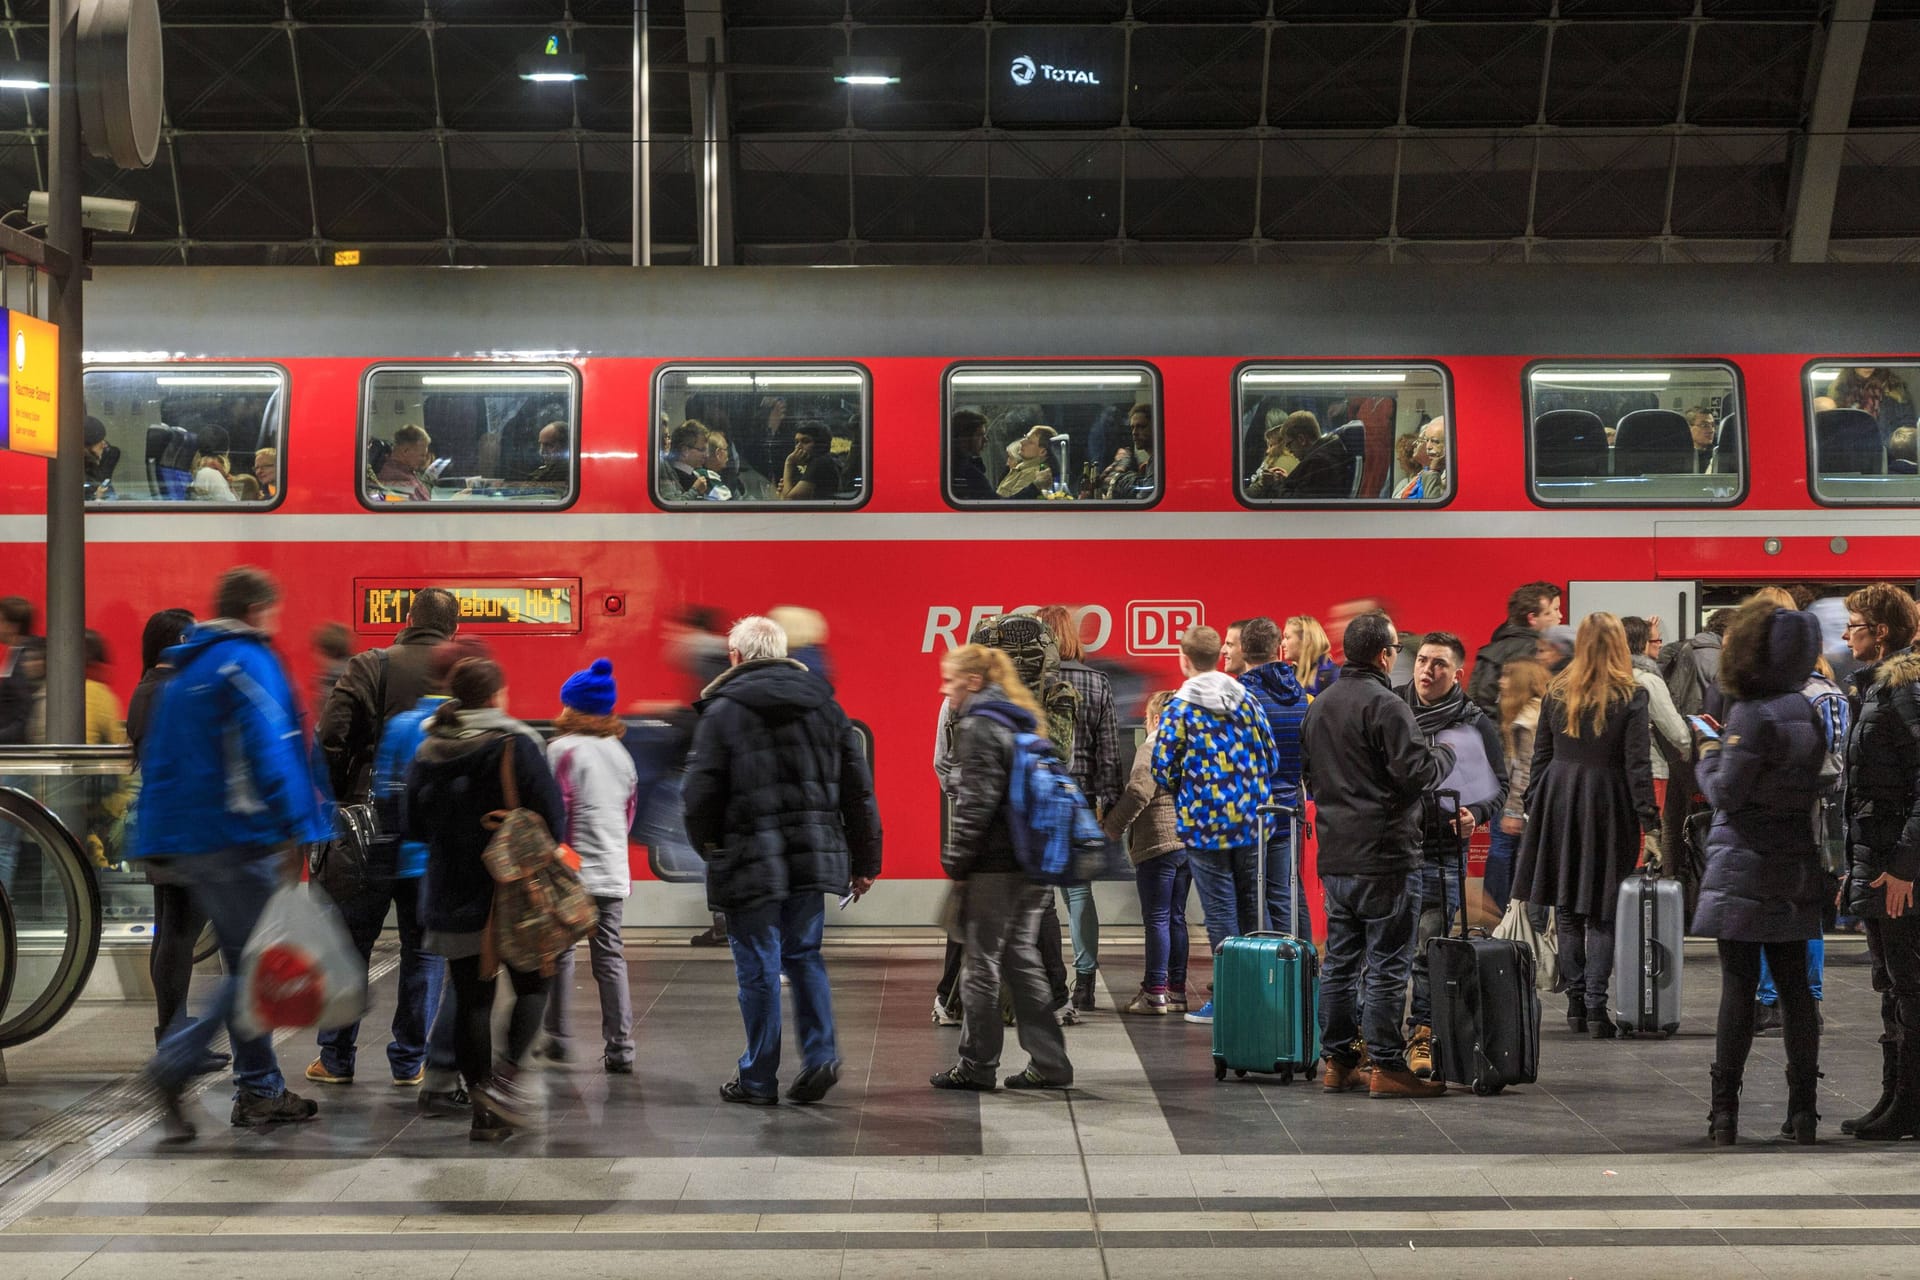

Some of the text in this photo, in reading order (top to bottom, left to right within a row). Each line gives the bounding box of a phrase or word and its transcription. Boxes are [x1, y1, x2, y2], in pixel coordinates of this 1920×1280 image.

[369, 589, 561, 623] RE1 eburg Hbf
[1138, 610, 1192, 645] DB
